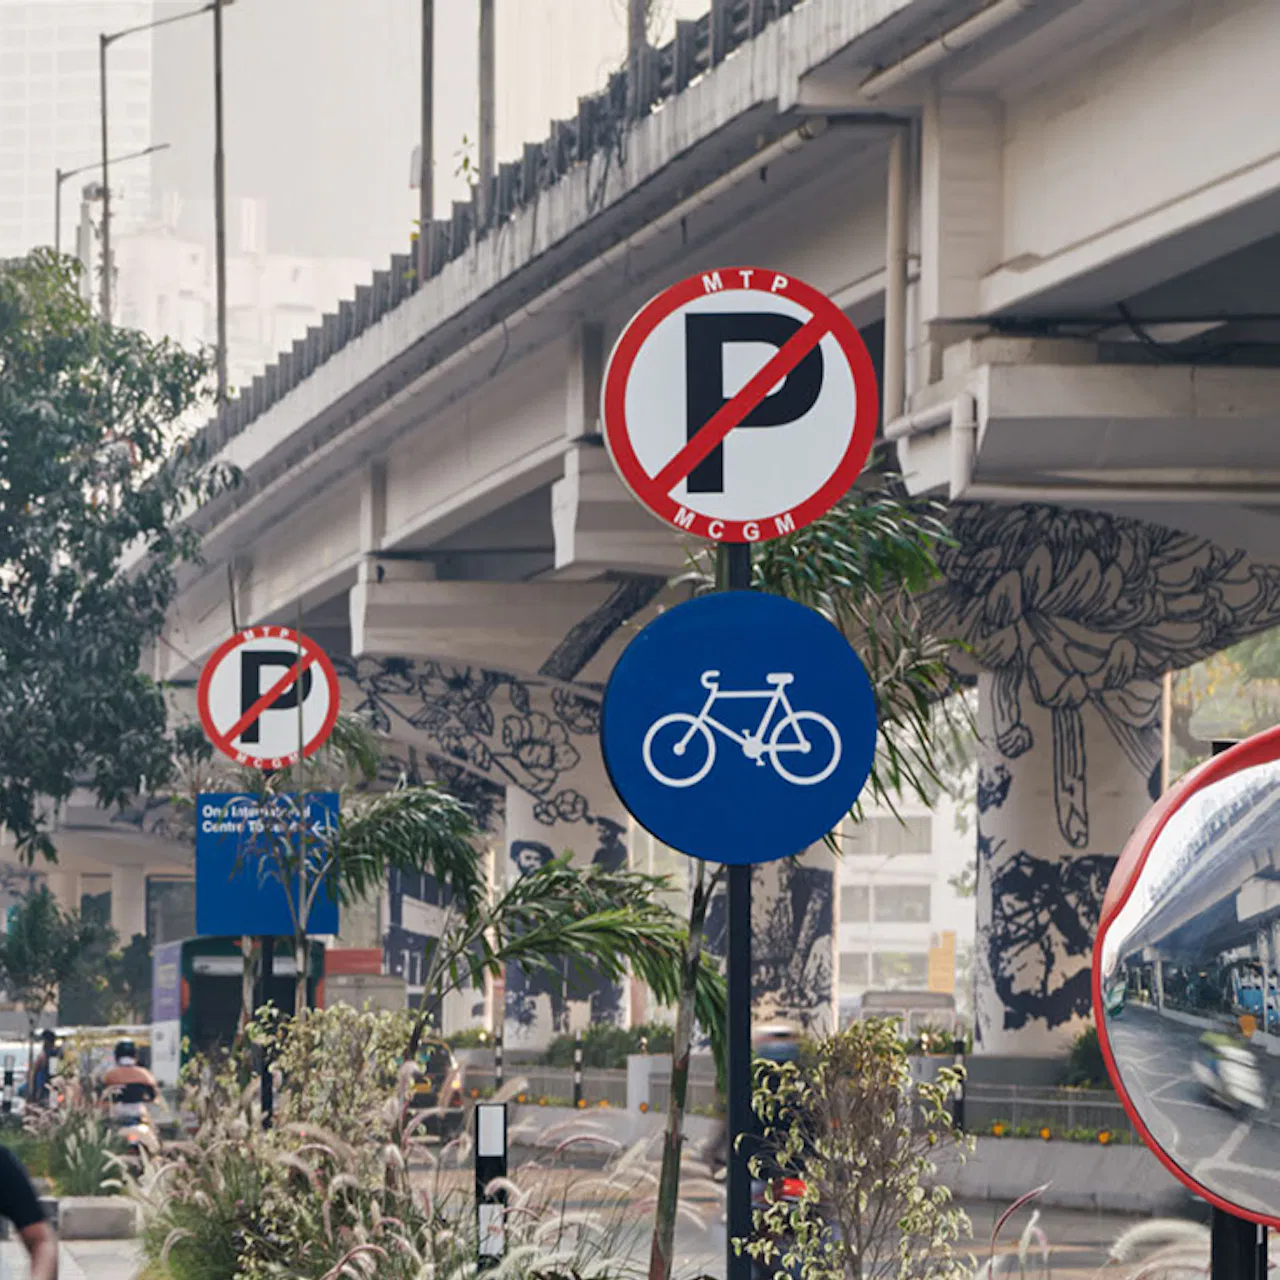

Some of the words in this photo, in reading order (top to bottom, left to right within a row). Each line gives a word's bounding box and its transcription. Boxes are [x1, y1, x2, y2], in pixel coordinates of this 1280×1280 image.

[700, 269, 789, 294] MTP
[685, 312, 824, 493] P
[673, 506, 796, 541] MCGM
[242, 626, 290, 642] MTP
[235, 751, 299, 769] MCGM
